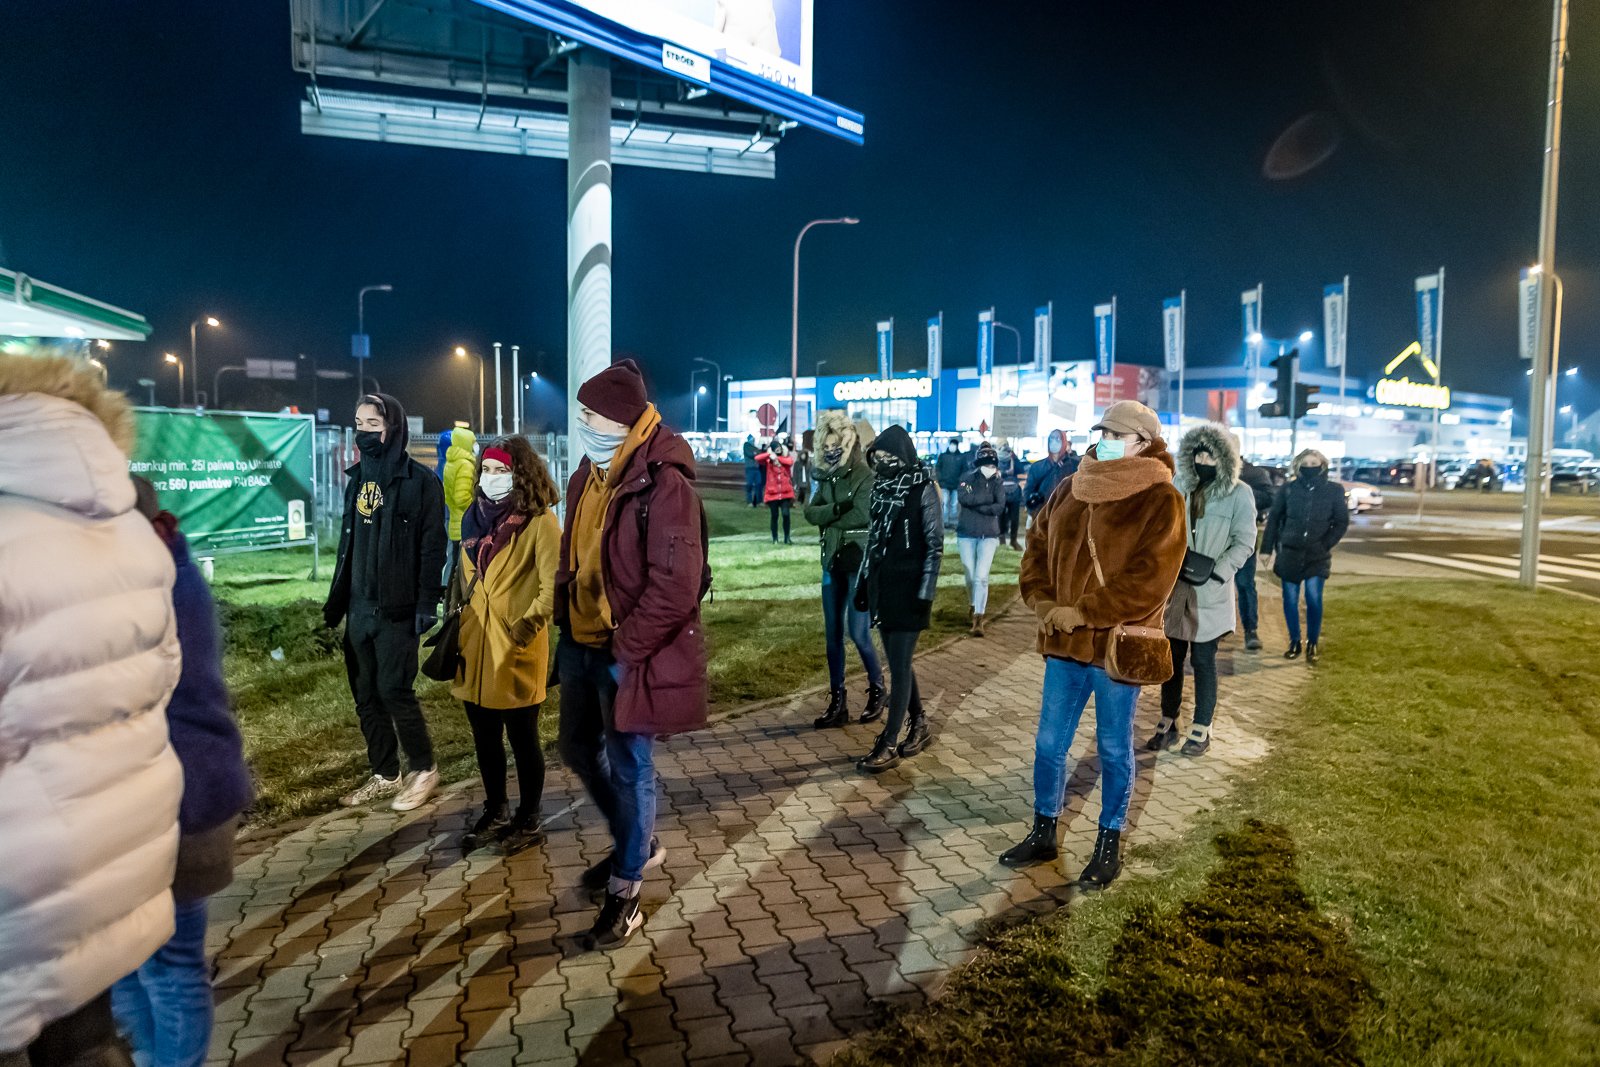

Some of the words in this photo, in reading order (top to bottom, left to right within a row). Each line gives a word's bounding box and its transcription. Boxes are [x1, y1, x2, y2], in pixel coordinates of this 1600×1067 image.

[834, 377, 932, 401] castorama
[168, 460, 189, 472] min.
[207, 459, 234, 473] paliwa
[235, 459, 247, 473] bp
[189, 477, 232, 491] punktów
